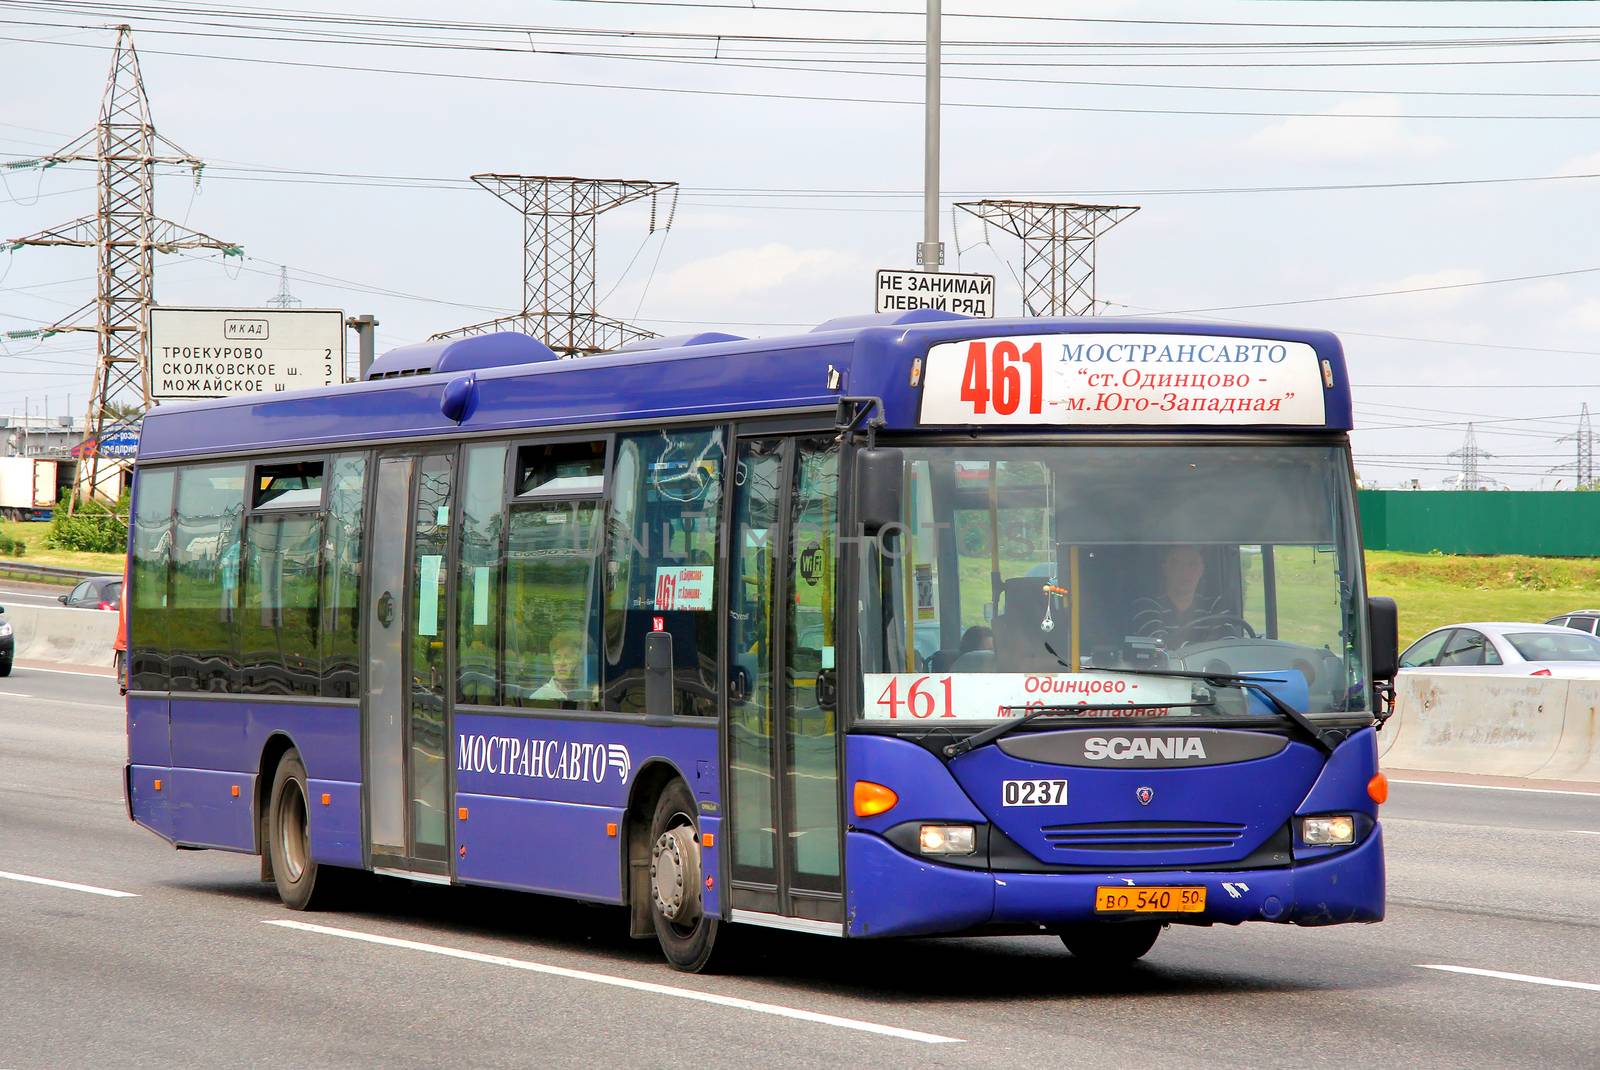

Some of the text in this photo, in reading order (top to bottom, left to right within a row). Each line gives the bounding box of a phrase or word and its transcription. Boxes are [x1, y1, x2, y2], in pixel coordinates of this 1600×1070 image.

[880, 275, 991, 295] НЕ ЗАНИМАЙ
[883, 294, 986, 316] ЛЕВЫЙ РЯД
[229, 324, 264, 335] МКАД
[162, 347, 332, 360] ТРОЕКУРОВО 2
[1059, 343, 1288, 364] МОСТРАНСАВТО
[162, 363, 276, 375] СКОЛКОВСКОЕ
[324, 364, 333, 376] 3
[960, 340, 1043, 416] 461
[162, 376, 263, 392] МОЖАЙСКОЕ
[656, 574, 677, 612] 461
[876, 675, 957, 719] 461
[1024, 676, 1126, 697] Одинцово
[457, 734, 607, 784] МОСТРАНСАВТО
[1083, 737, 1207, 760] SCANIA
[1005, 781, 1067, 805] 0237
[1136, 891, 1170, 909] 540
[1181, 890, 1199, 904] 50
